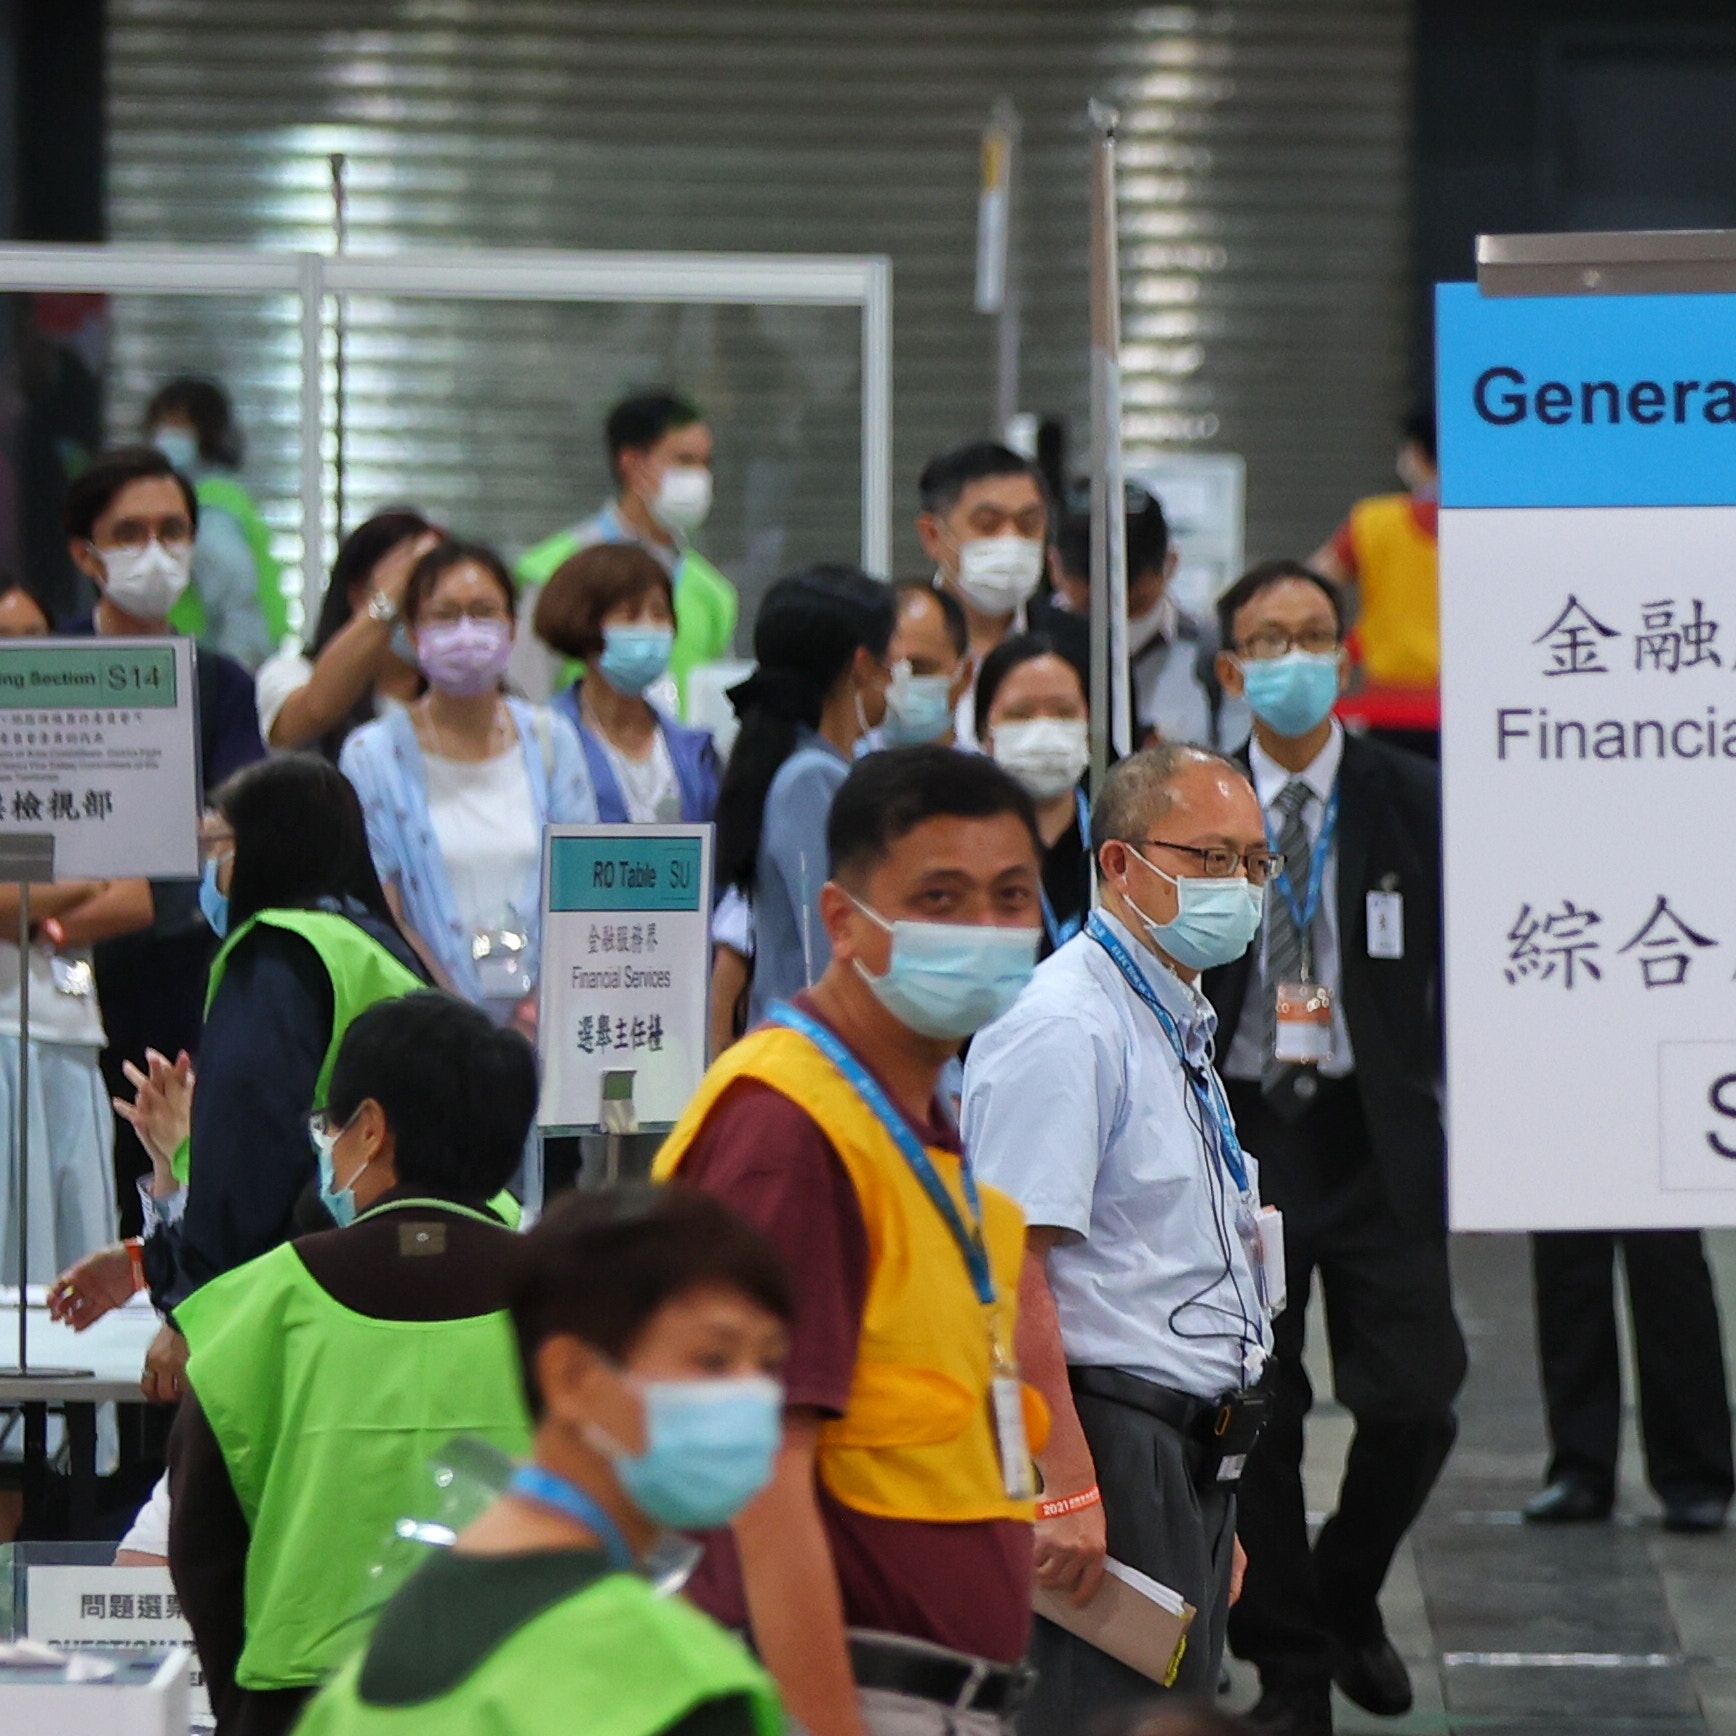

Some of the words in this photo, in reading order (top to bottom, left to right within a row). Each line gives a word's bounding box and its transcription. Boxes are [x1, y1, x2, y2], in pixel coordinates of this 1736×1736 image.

[30, 670, 97, 687] Section
[108, 665, 160, 691] S14
[592, 860, 615, 890] RO
[619, 860, 658, 890] Table
[669, 859, 691, 890] SU
[587, 922, 660, 956] 金融服務界
[571, 964, 622, 990] Financial
[623, 963, 672, 990] Services
[1042, 1499, 1070, 1517] 2021
